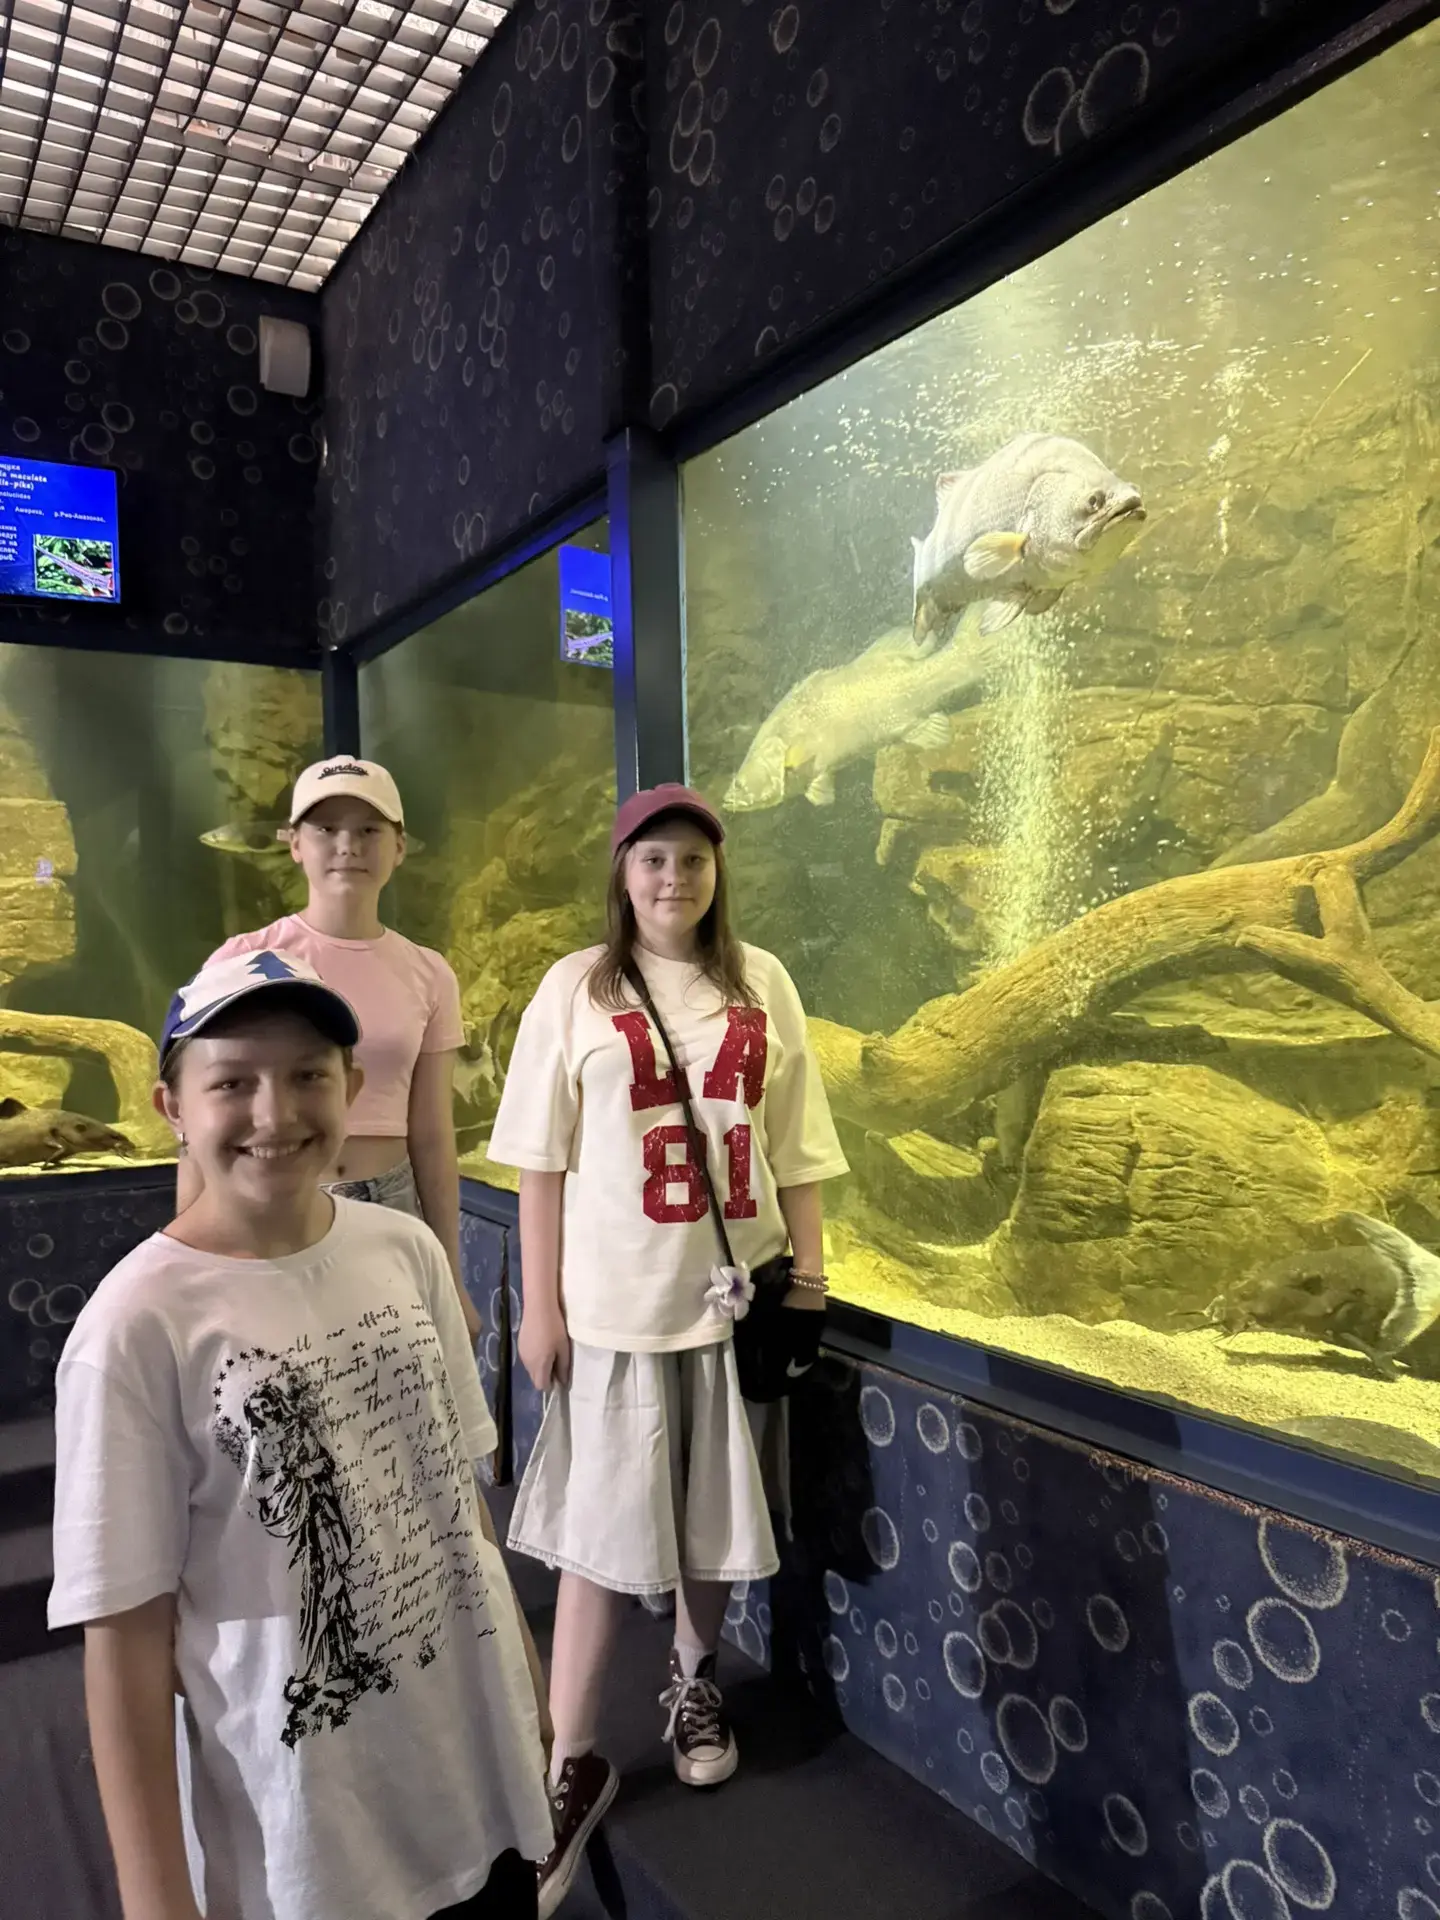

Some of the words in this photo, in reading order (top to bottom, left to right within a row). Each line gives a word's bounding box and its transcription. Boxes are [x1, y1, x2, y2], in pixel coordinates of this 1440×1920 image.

[10, 472, 48, 483] maculata
[612, 1006, 767, 1111] LA
[643, 1124, 757, 1223] 81
[357, 1304, 399, 1329] efforts
[372, 1343, 399, 1363] the
